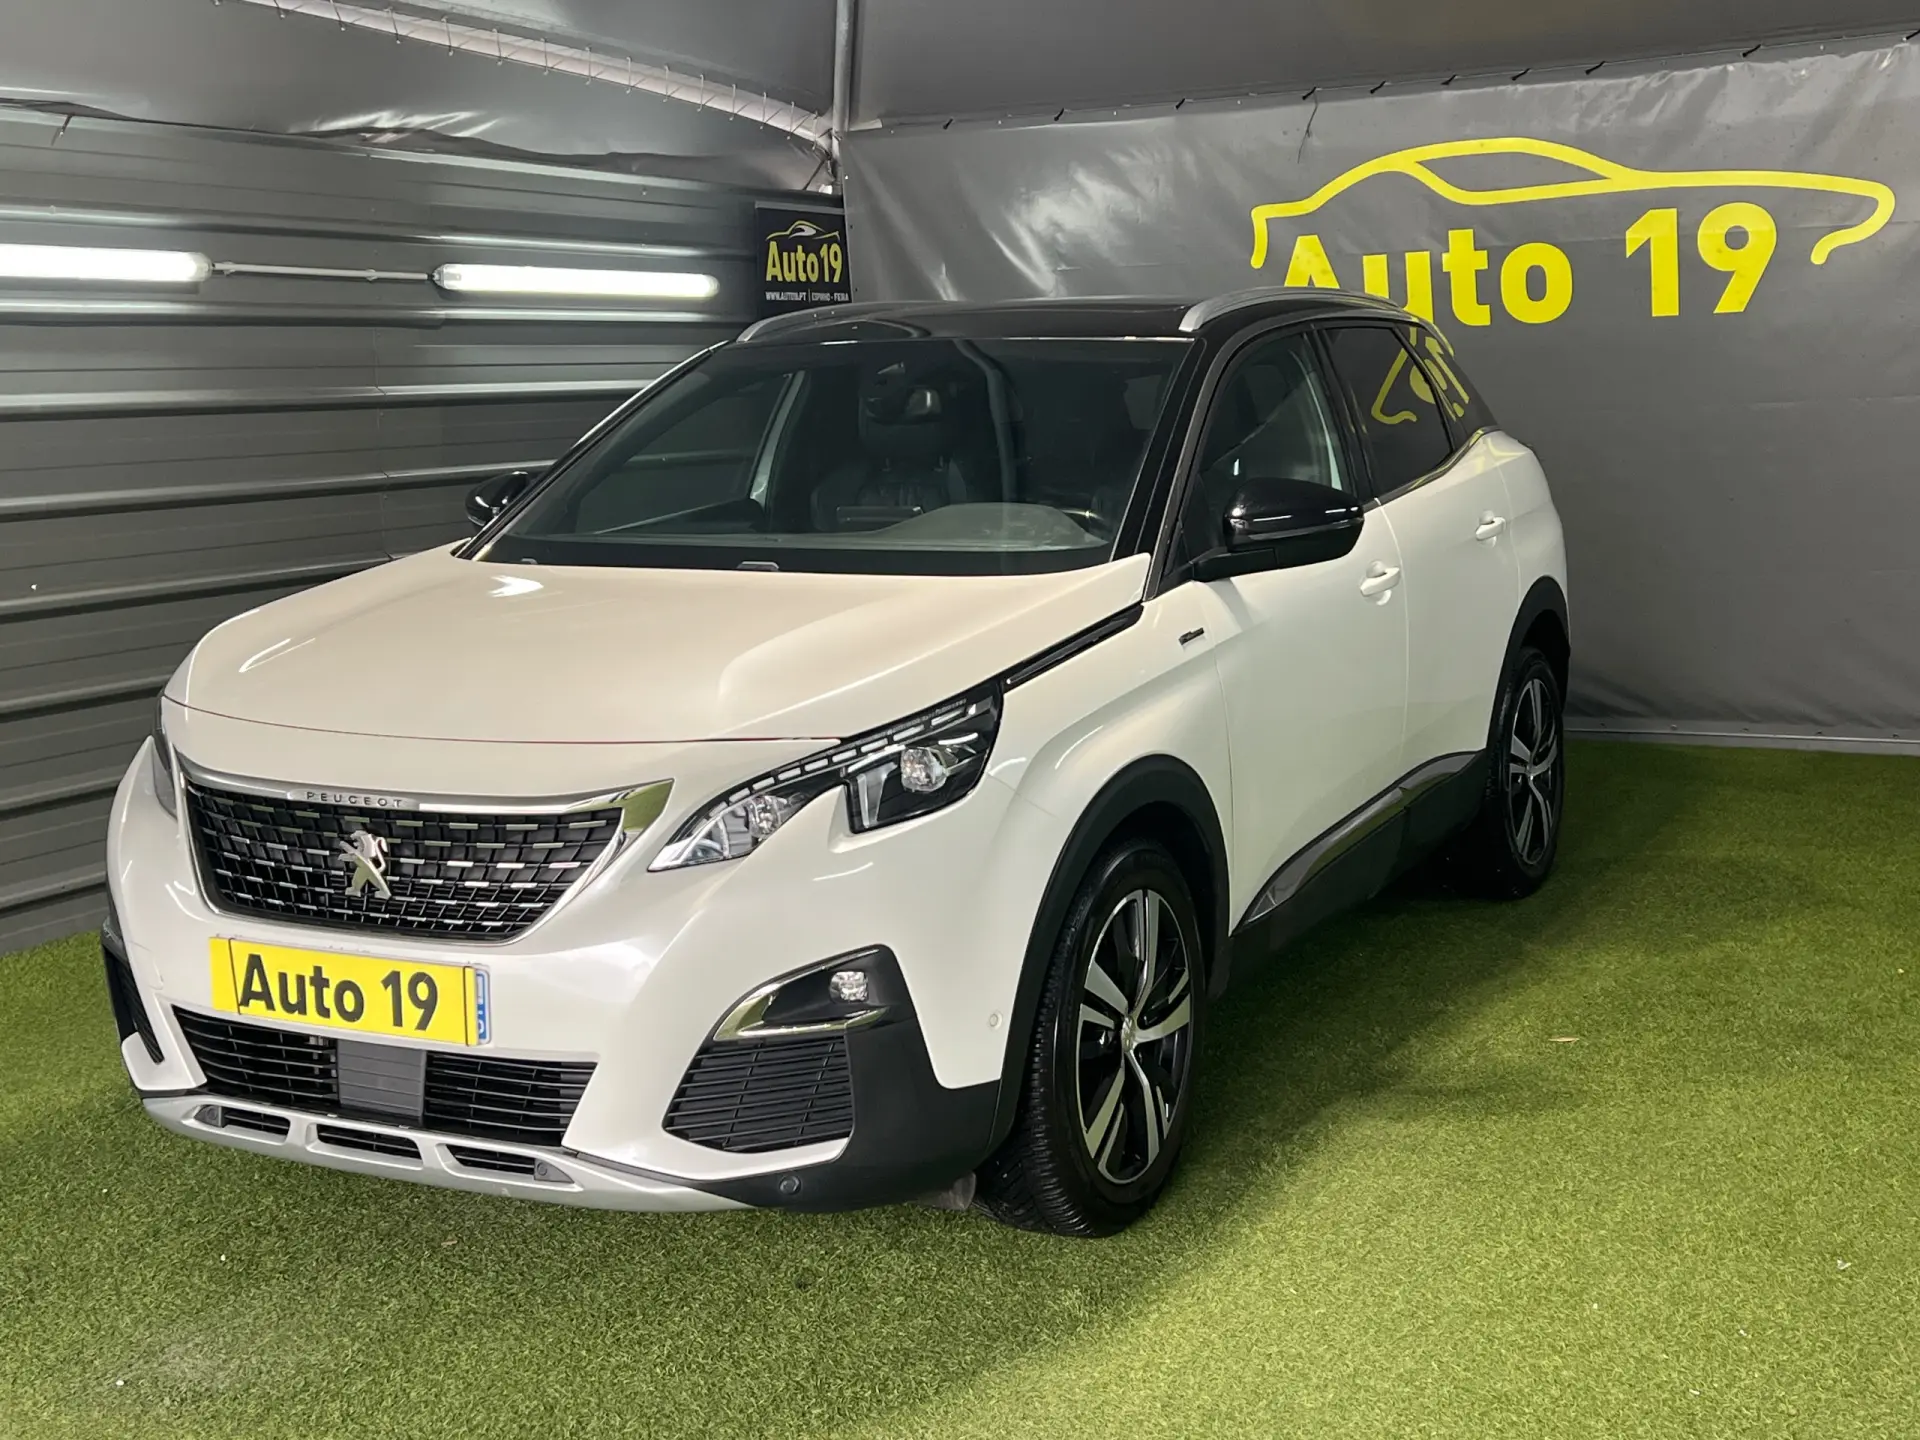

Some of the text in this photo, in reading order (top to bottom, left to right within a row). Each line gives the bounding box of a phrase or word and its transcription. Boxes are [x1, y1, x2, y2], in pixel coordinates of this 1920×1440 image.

[765, 240, 843, 283] Auto 19
[1284, 202, 1778, 326] Auto 19
[306, 791, 402, 808] PEUGEOT
[239, 953, 365, 1023] Auto
[380, 970, 439, 1032] 19
